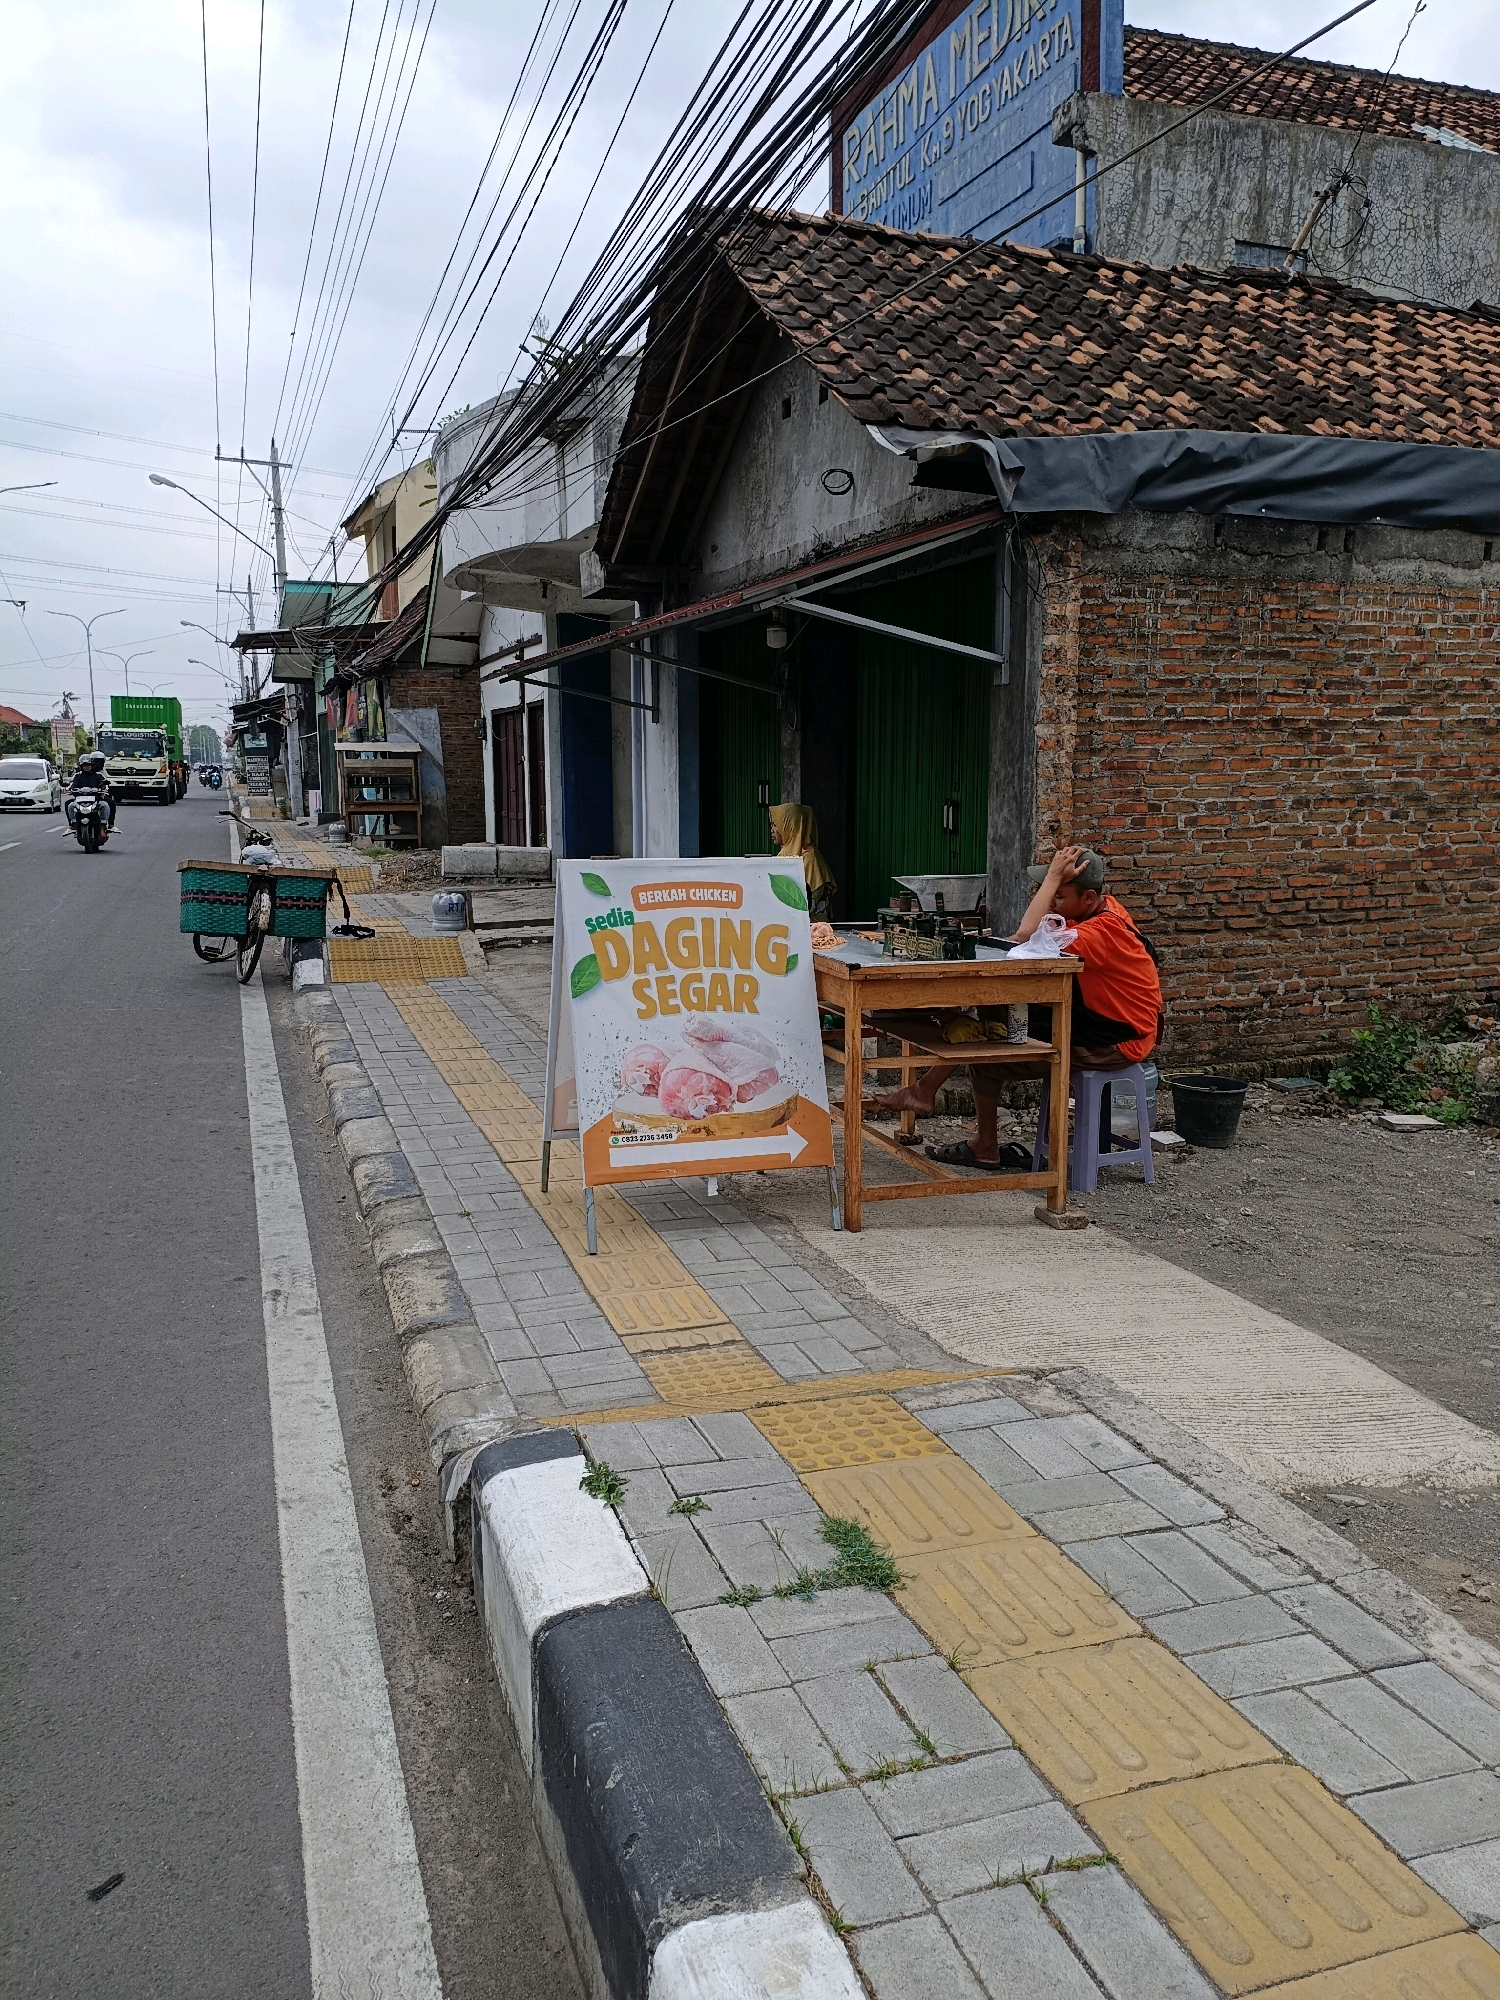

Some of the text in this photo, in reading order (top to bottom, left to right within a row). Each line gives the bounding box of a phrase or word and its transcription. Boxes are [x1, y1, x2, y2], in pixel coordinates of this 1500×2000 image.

[845, 0, 1058, 192] RAHMA MEDI
[859, 152, 916, 221] BANTUL
[943, 116, 955, 155] 9
[957, 12, 1075, 141] YOGYAKARTA
[584, 907, 635, 935] sedia
[638, 888, 737, 905] BERKAH CHICKEN
[589, 917, 790, 983] DAGING
[632, 972, 761, 1021] SEGAR
